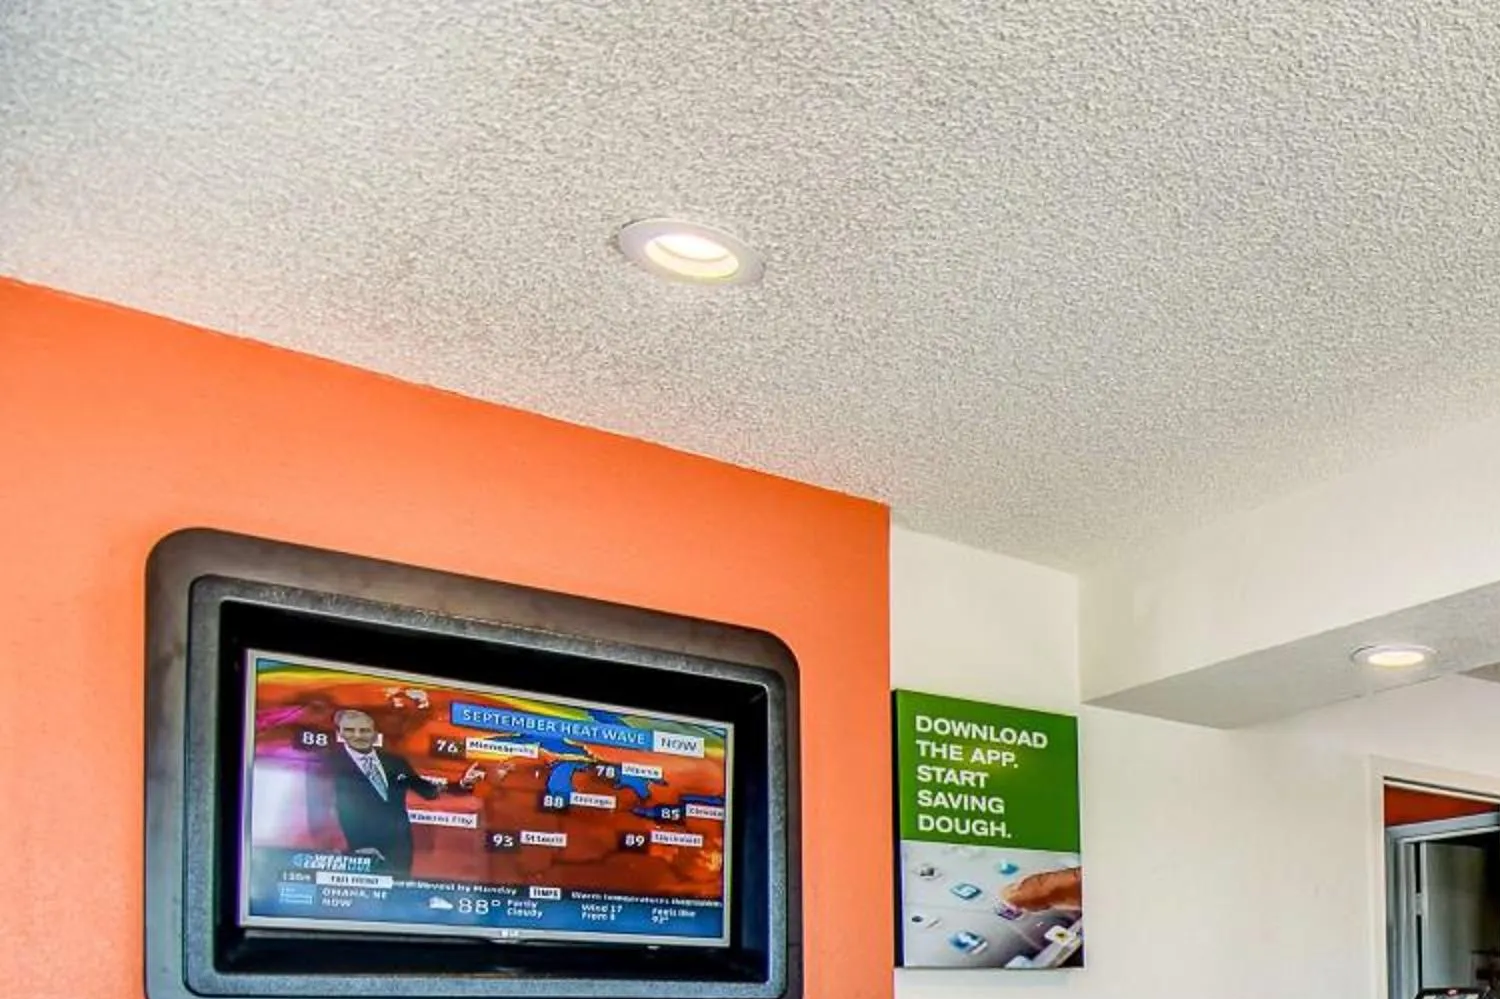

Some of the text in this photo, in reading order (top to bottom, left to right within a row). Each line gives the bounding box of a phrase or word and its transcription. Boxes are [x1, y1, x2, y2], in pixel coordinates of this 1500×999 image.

[462, 708, 647, 746] SEPTEMBER HEAT WAVE
[915, 715, 1049, 749] DOWNLOAD
[302, 732, 328, 747] 88
[436, 739, 458, 754] 76
[660, 737, 698, 753] NOW
[916, 739, 1020, 769] THE APP.
[595, 765, 616, 779] 78
[916, 765, 990, 789] START
[543, 795, 564, 809] 88
[917, 790, 1005, 815] SAVING
[660, 807, 681, 821] 85
[918, 814, 1012, 838] DOUGH.
[492, 833, 514, 848] 93
[624, 834, 645, 848] 89
